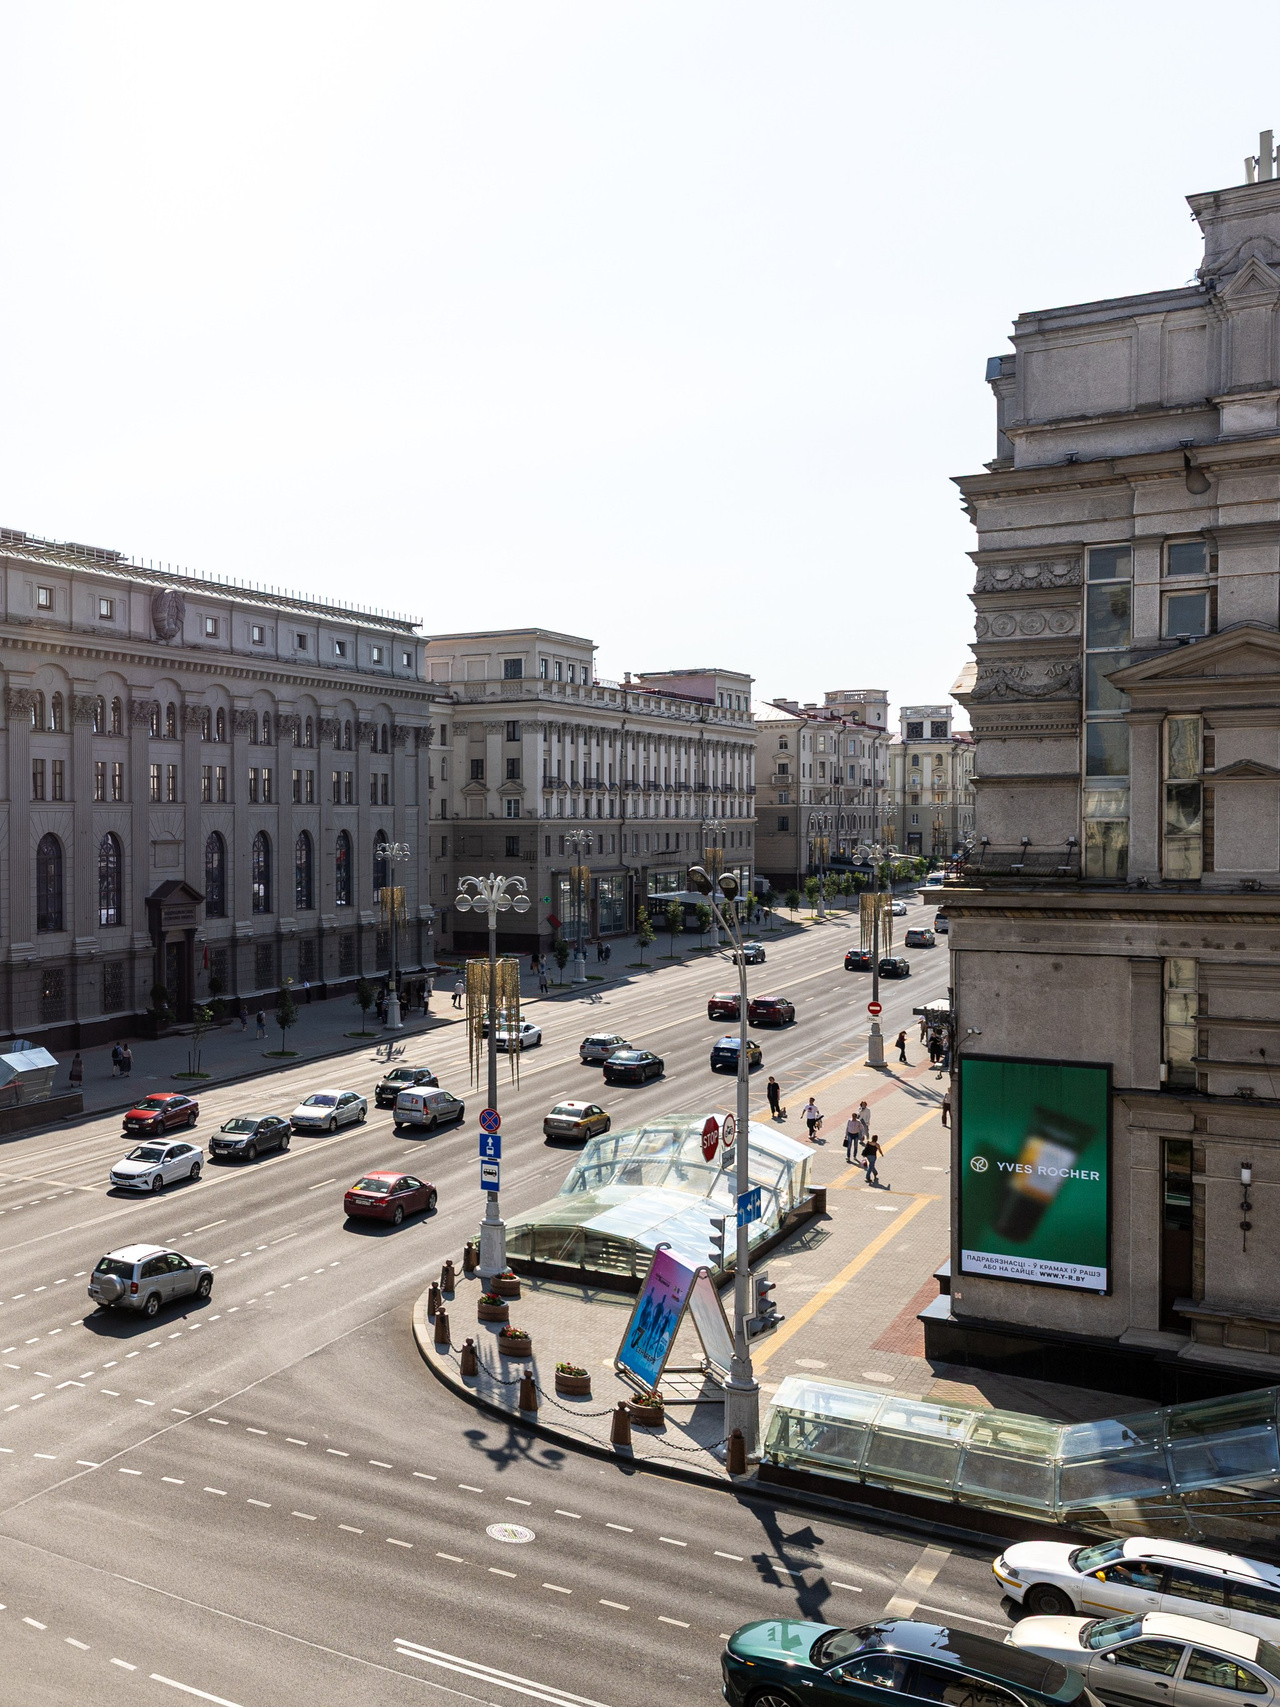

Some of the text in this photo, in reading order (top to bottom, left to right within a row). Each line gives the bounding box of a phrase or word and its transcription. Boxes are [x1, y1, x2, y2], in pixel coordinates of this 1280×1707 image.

[702, 1129, 718, 1149] STOP
[997, 1161, 1100, 1181] YVES ROCHER
[966, 1254, 1026, 1268] ПАДРАБЯЗНАСЦІ
[1039, 1264, 1069, 1274] КРАМАХ
[1079, 1269, 1101, 1278] РАШЭ
[982, 1263, 997, 1271] АБО
[998, 1265, 1009, 1273] НА
[1039, 1270, 1086, 1282] WWW.Y-R.BY
